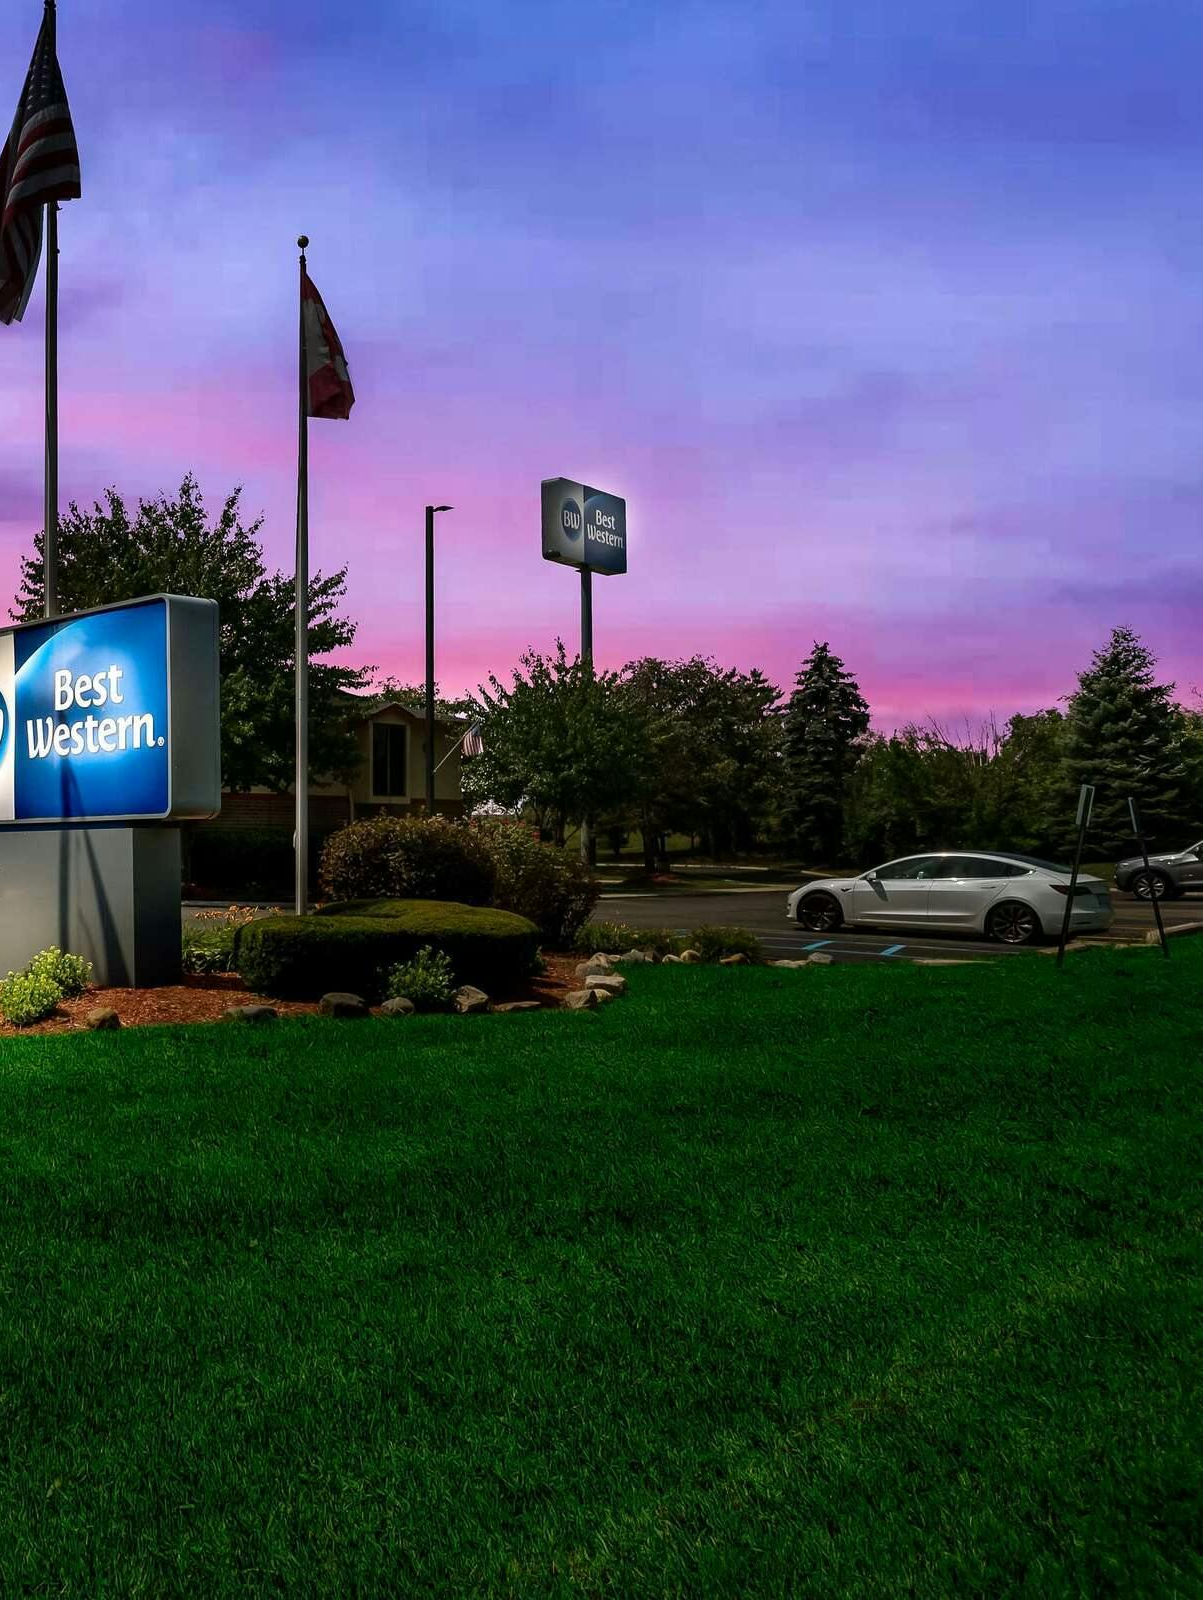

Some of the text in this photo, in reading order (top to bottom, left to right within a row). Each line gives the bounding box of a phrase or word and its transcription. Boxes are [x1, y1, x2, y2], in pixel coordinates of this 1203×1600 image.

[563, 510, 580, 530] BW
[595, 509, 616, 530] Best
[587, 523, 624, 548] Western
[54, 664, 124, 711] Best
